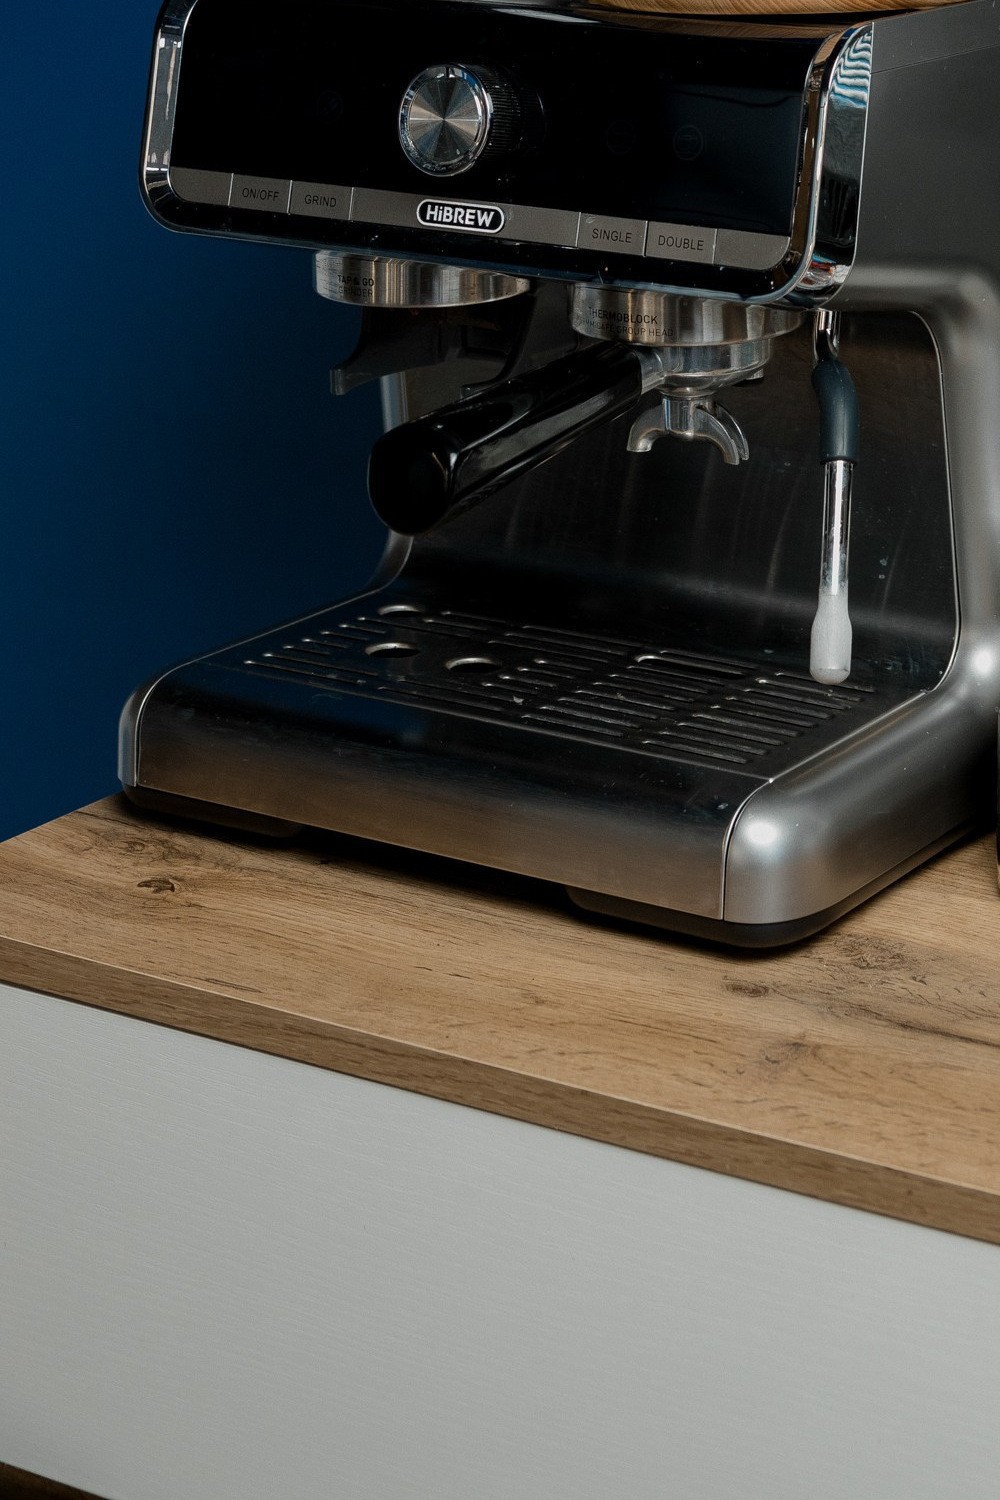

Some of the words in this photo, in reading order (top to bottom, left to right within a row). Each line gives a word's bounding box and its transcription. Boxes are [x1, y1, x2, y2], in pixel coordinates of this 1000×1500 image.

[242, 187, 279, 202] ON/OFF
[304, 194, 337, 208] GRIND
[425, 204, 495, 227] HiBREW
[592, 228, 632, 244] SINGLE
[657, 235, 705, 251] DOUBLE
[338, 274, 352, 285] TAP
[362, 277, 375, 287] GO
[338, 285, 374, 298] GRINDER
[588, 306, 658, 325] THERMOBLOCK
[617, 326, 646, 337] GROUP
[648, 328, 675, 338] HEAD
